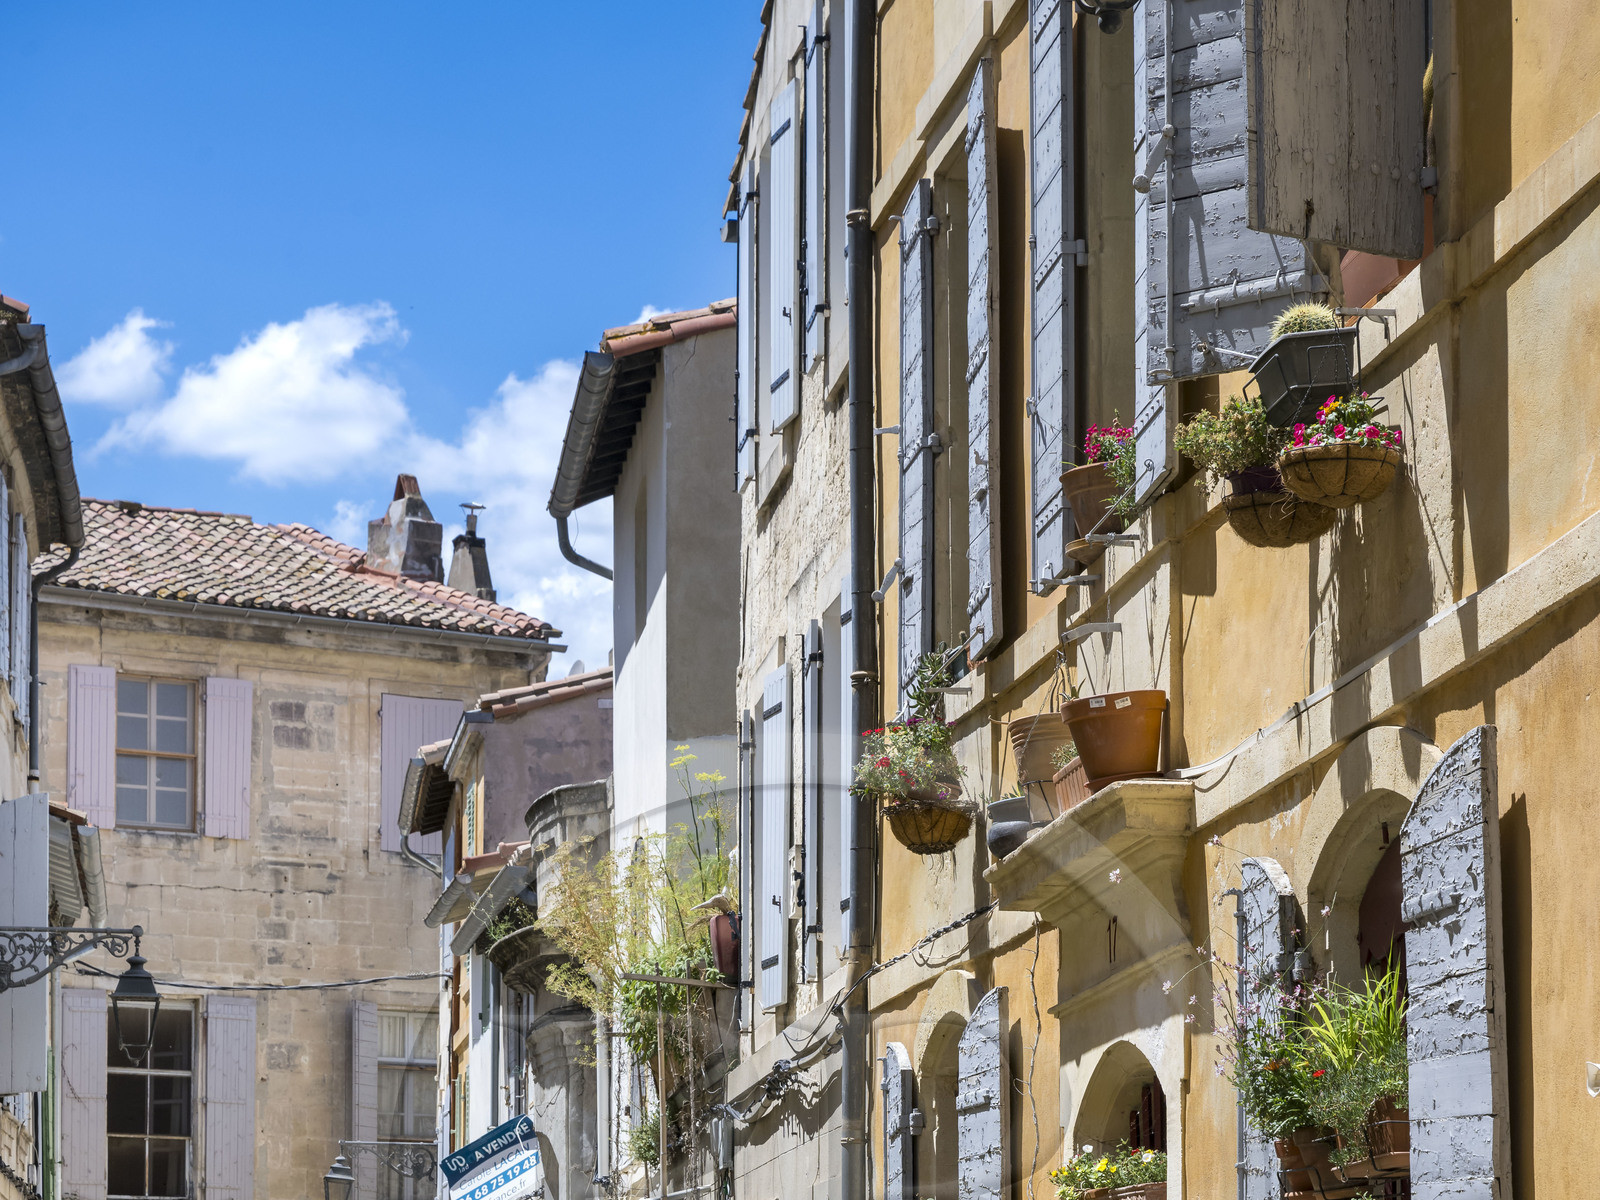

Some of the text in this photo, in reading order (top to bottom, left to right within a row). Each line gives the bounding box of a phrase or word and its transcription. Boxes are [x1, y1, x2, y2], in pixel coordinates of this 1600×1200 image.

[475, 1122, 530, 1162] A VENDRE
[459, 1168, 491, 1191] Carole
[474, 1185, 489, 1200] 68
[490, 1175, 505, 1190] 75
[507, 1165, 520, 1180] 19
[522, 1156, 537, 1170] 48
